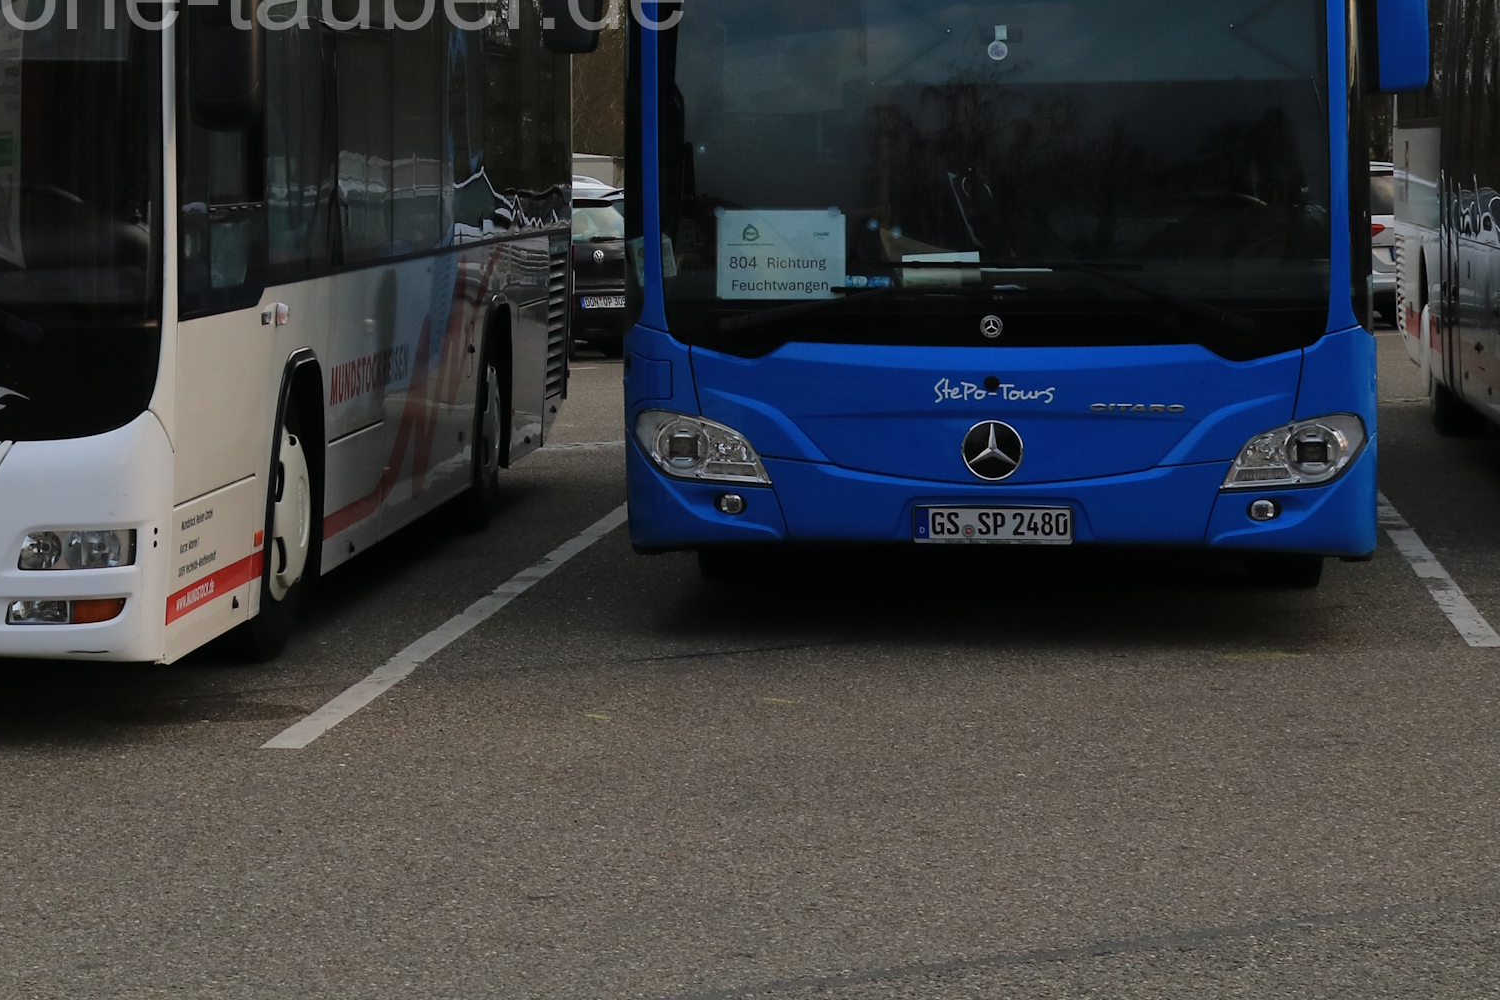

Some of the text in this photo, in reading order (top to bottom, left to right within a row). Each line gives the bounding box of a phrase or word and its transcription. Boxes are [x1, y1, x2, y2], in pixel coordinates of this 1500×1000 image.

[729, 256, 827, 271] 804 Richtung
[731, 279, 830, 293] Feuchtwangen
[933, 377, 1056, 404] StePo-Tours
[1088, 403, 1186, 414] CITARO
[931, 511, 960, 536] GS
[977, 511, 1006, 536] SP
[1012, 512, 1068, 537] 2480
